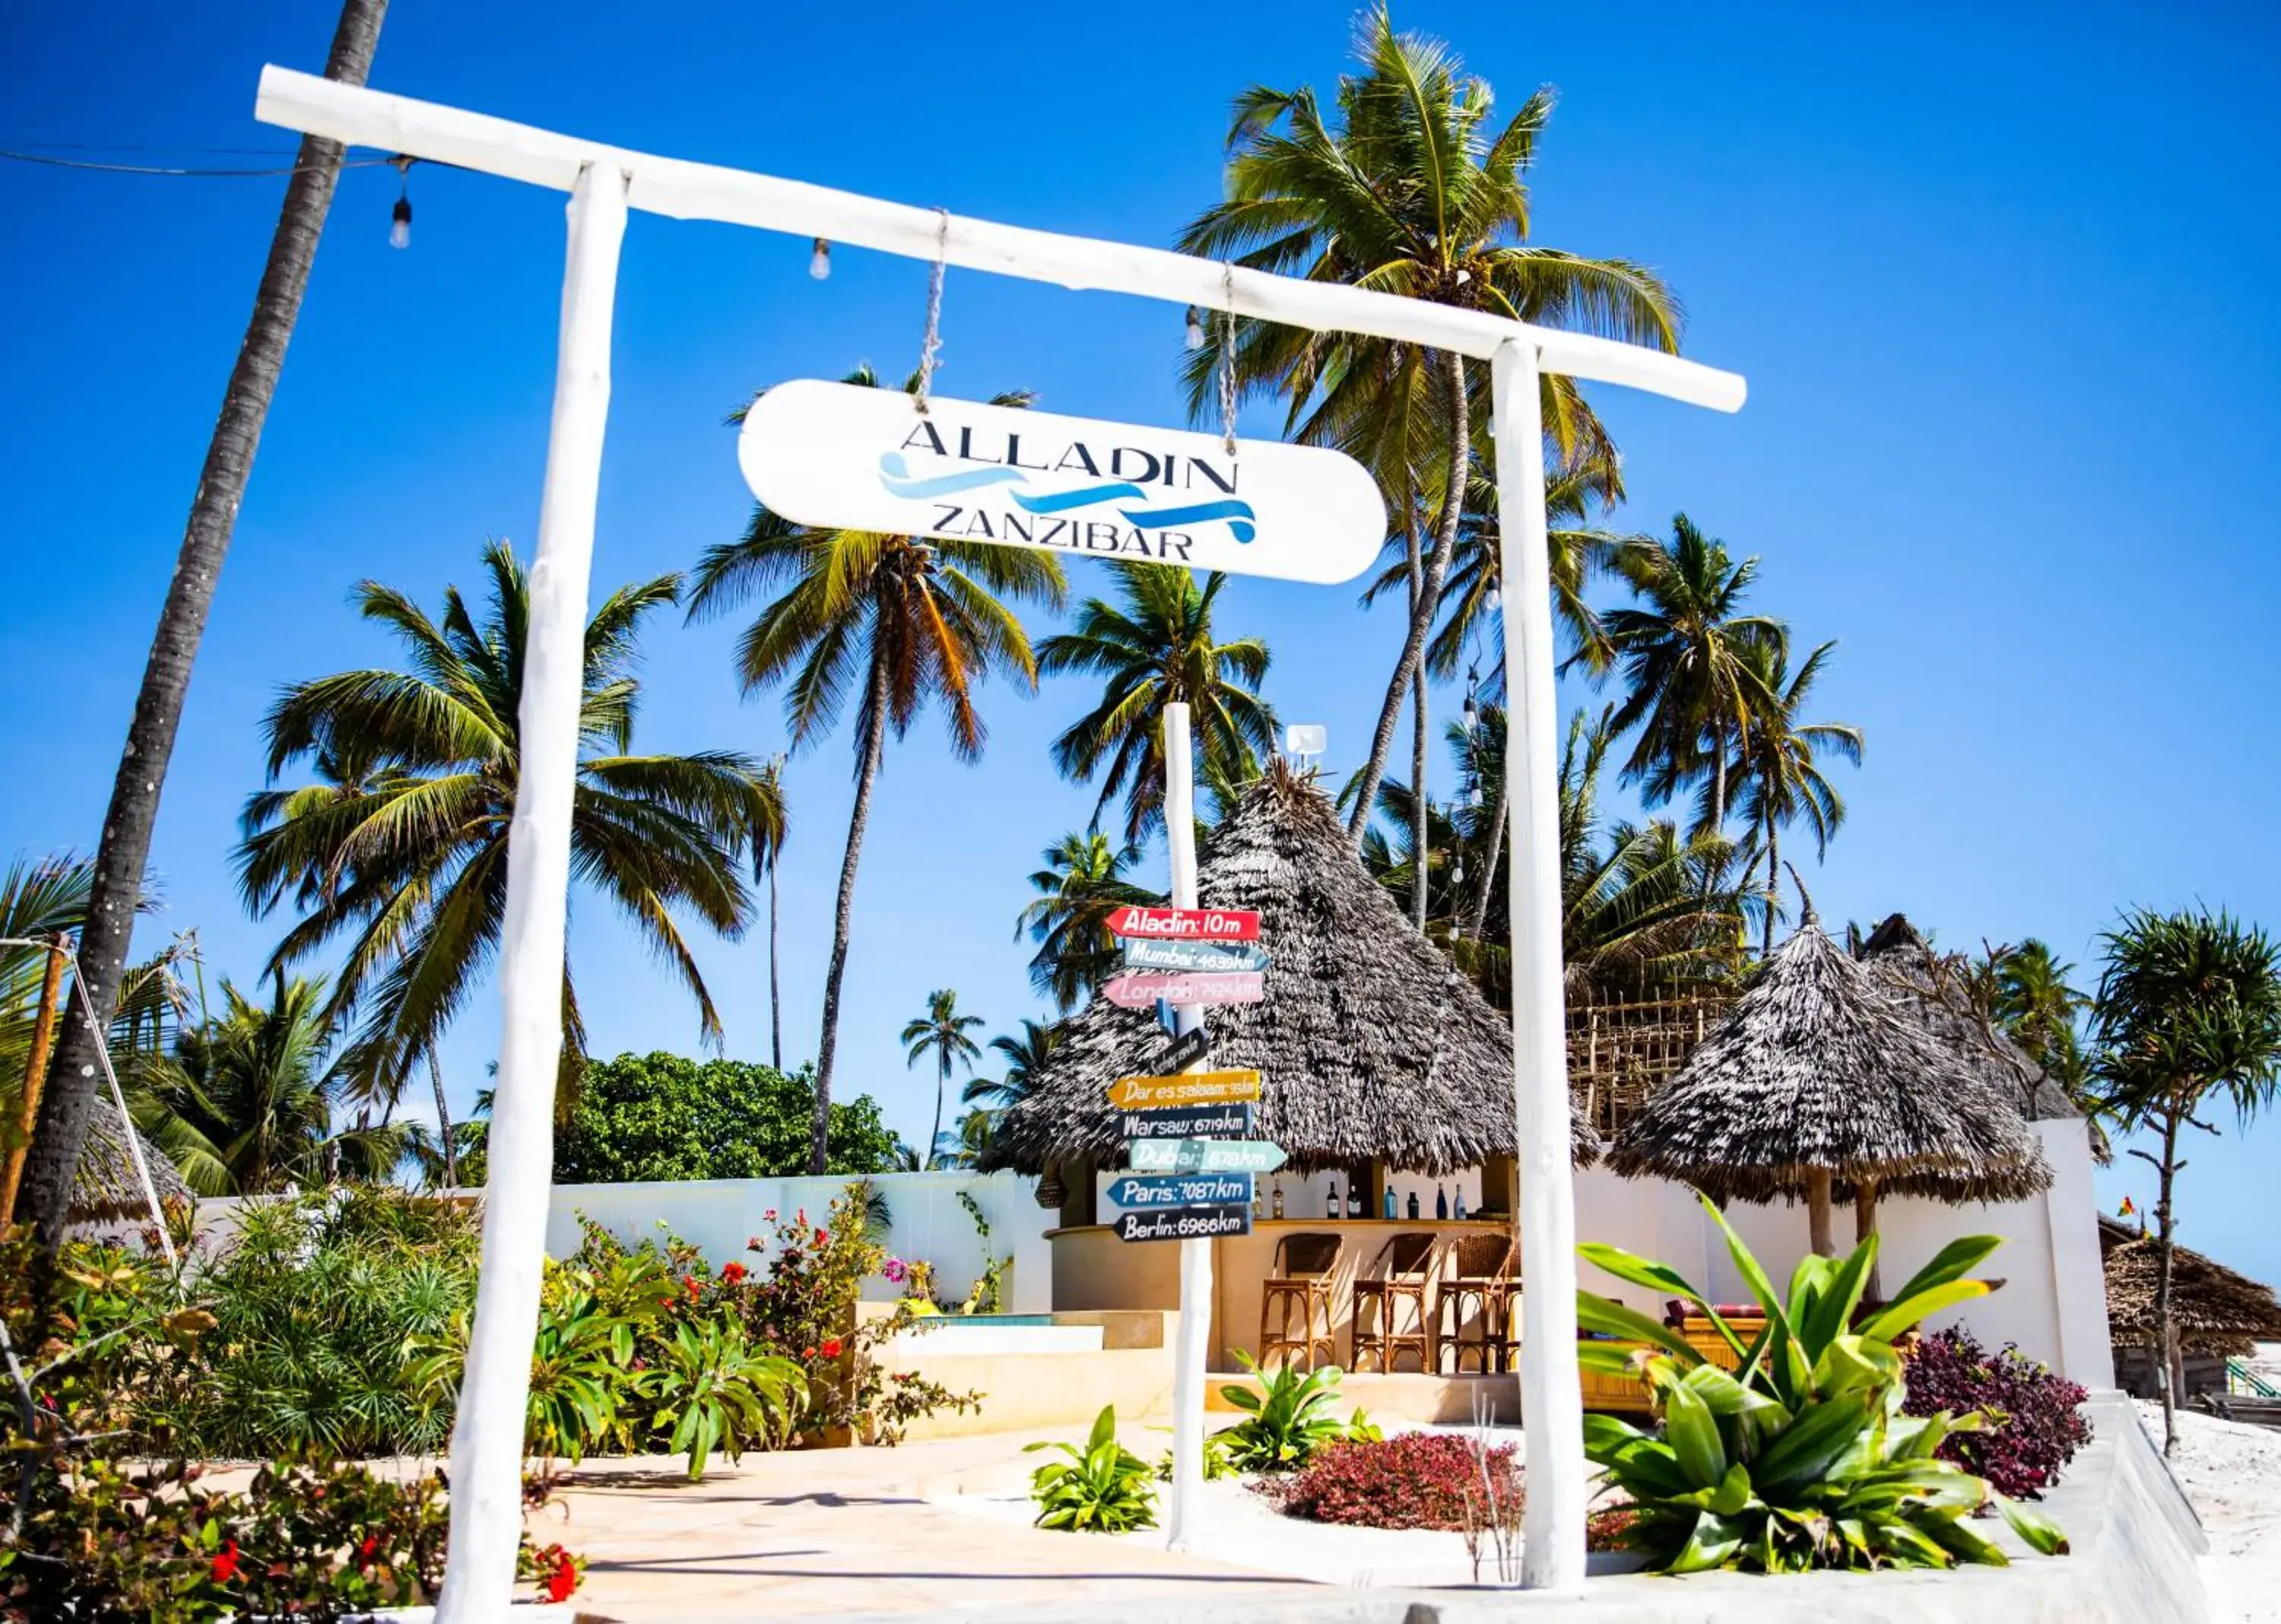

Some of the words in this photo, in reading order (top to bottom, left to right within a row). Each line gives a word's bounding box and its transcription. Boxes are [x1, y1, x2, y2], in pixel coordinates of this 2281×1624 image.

[900, 420, 1240, 495] ALLADIN
[931, 503, 1194, 562] ZANZIBAR
[1123, 1081, 1150, 1102] Dar
[1155, 1086, 1175, 1099] es
